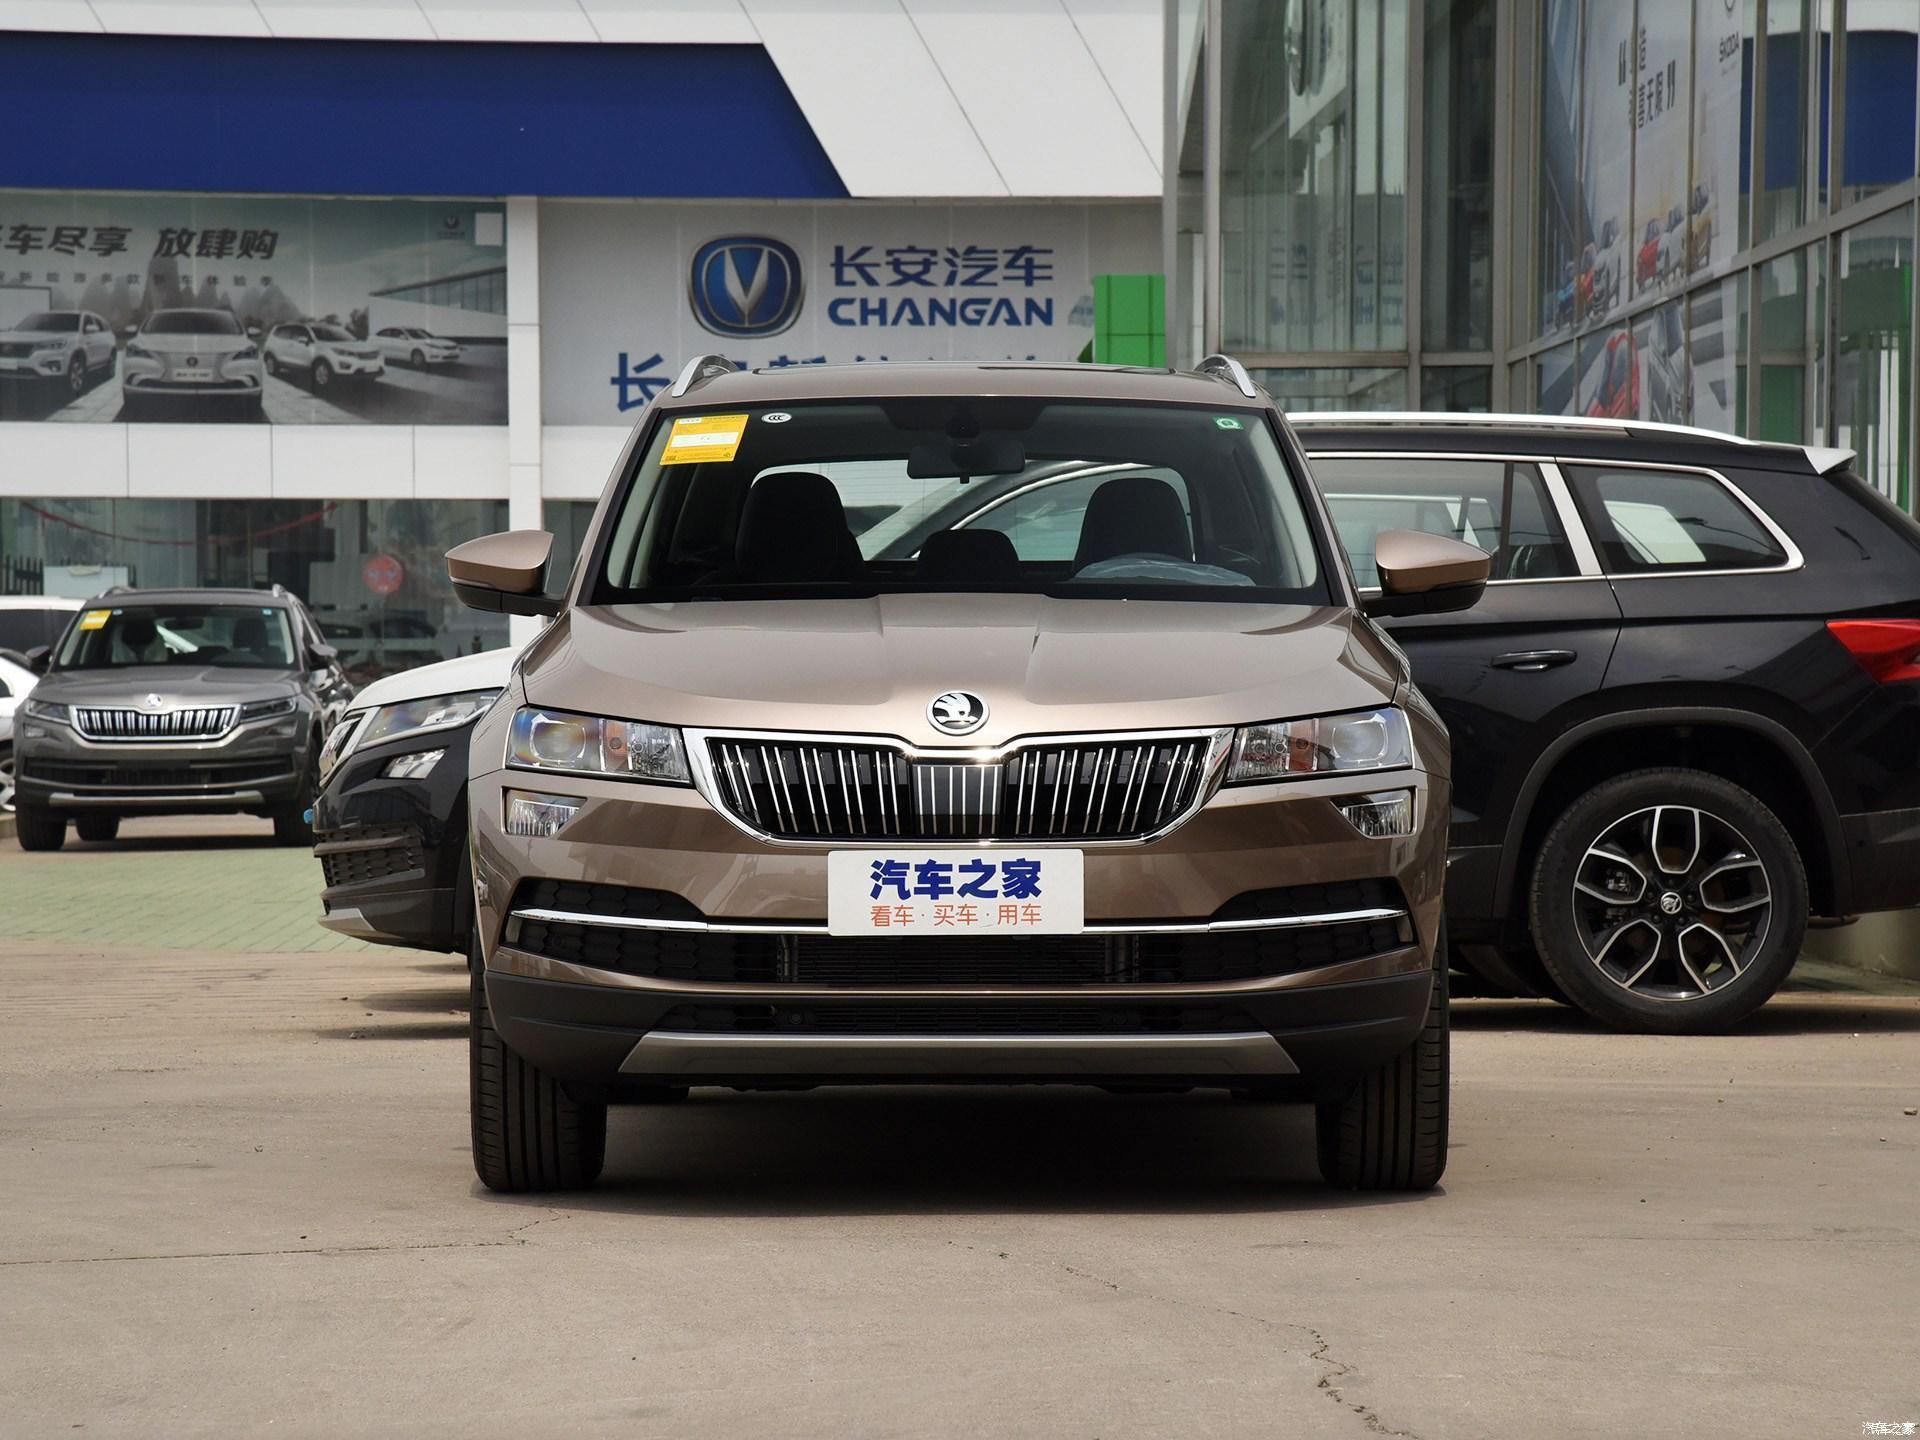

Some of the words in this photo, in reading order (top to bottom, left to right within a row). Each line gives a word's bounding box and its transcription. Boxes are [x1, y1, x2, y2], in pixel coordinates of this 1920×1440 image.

[0, 224, 133, 256] 车尽享
[154, 227, 280, 260] 放肆购
[829, 244, 1053, 288] 长安汽车
[827, 297, 1053, 328] CHANGAN
[869, 857, 1042, 901] 汽车之家
